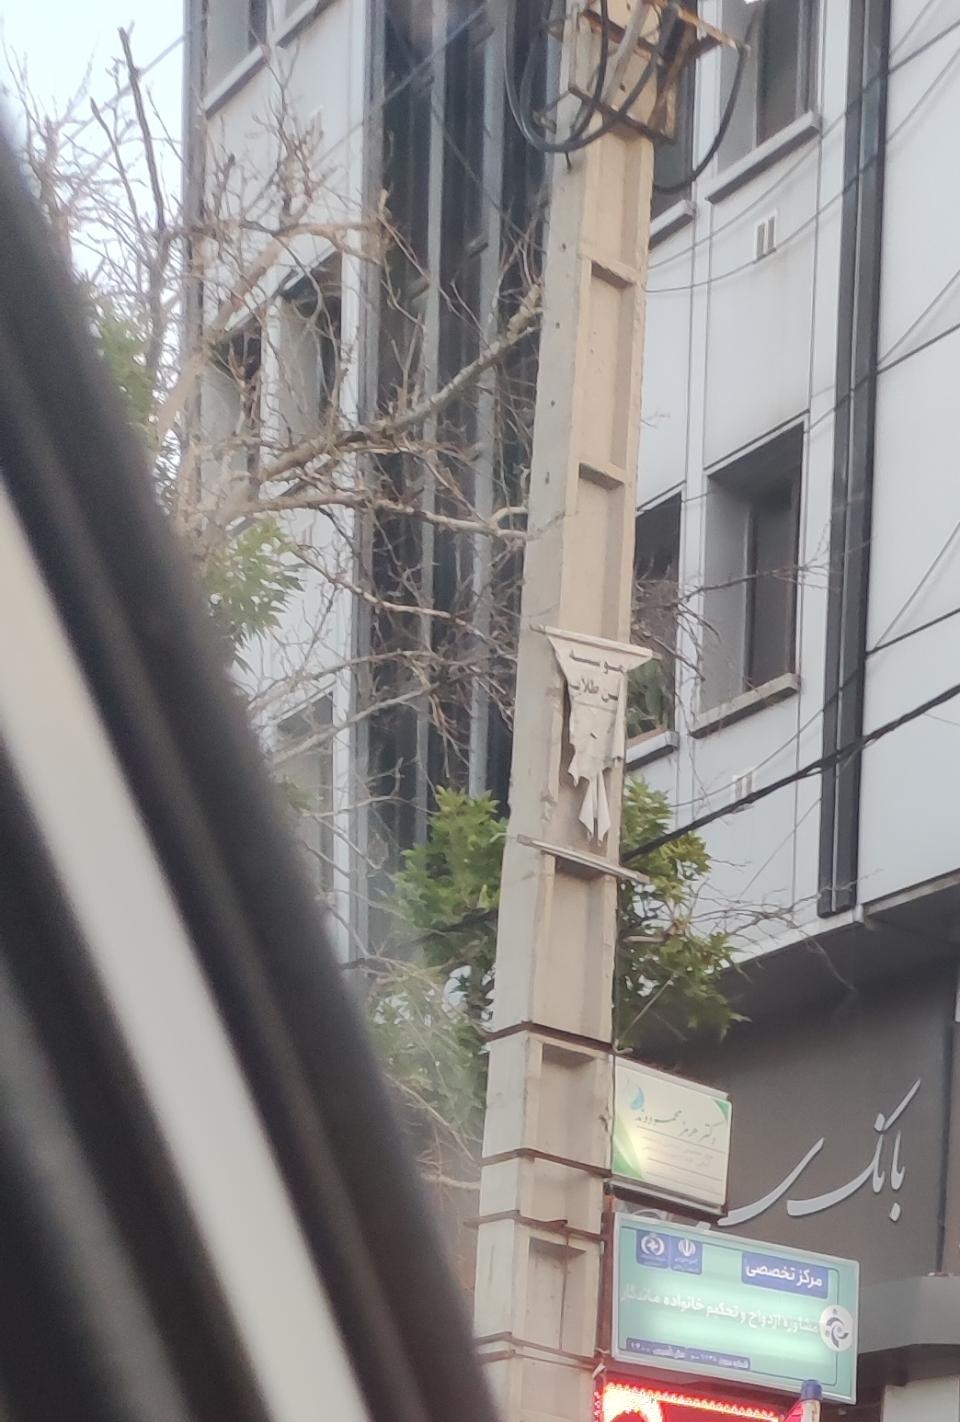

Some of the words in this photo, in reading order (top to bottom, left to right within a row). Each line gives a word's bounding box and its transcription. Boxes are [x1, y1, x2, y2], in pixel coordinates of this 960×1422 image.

[786, 1079, 922, 1223] بانک
[744, 1261, 796, 1282] تخصصی
[796, 1268, 823, 1290] مرکز
[663, 1293, 705, 1313] خانواده
[705, 1301, 740, 1319] تحکیم
[747, 1309, 782, 1329] ازدواج
